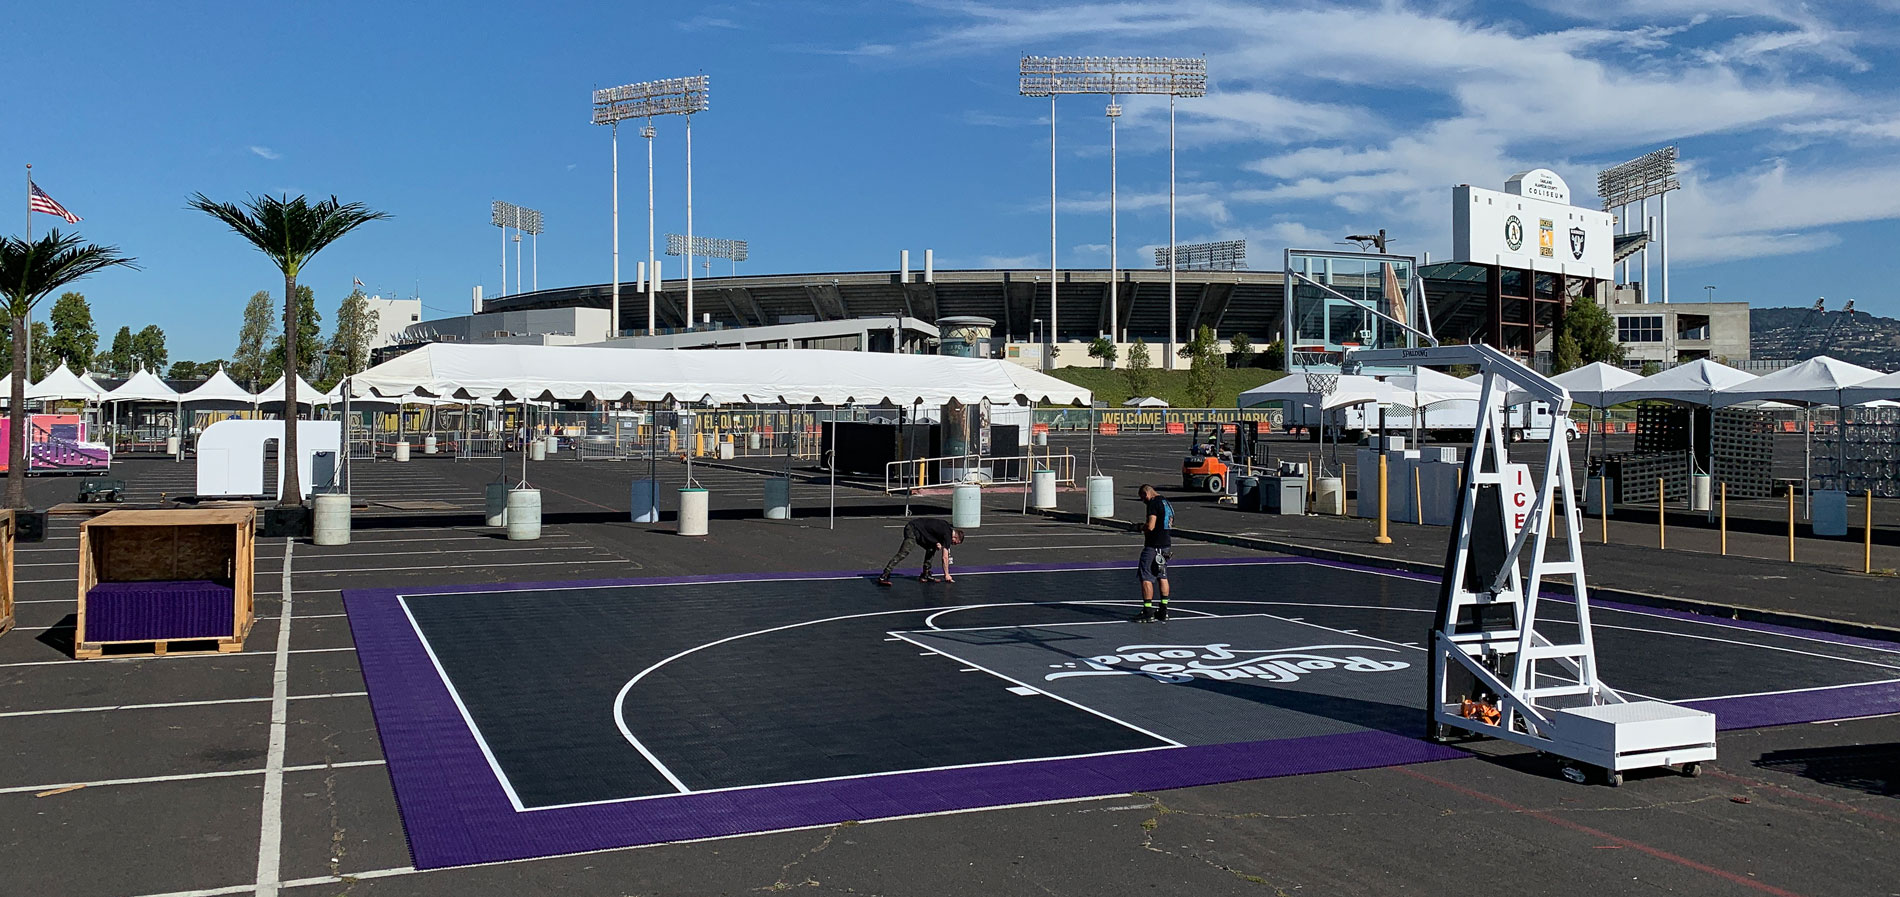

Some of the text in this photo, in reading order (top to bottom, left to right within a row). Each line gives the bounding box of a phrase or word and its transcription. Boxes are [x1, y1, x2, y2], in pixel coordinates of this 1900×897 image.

[1529, 187, 1563, 199] COLISEUM
[1402, 349, 1428, 359] SPALDING
[1101, 412, 1161, 425] WELCOME
[1164, 412, 1180, 424] TO
[1182, 412, 1204, 424] THE
[1513, 470, 1526, 530] ICE
[1120, 653, 1411, 685] Rolling
